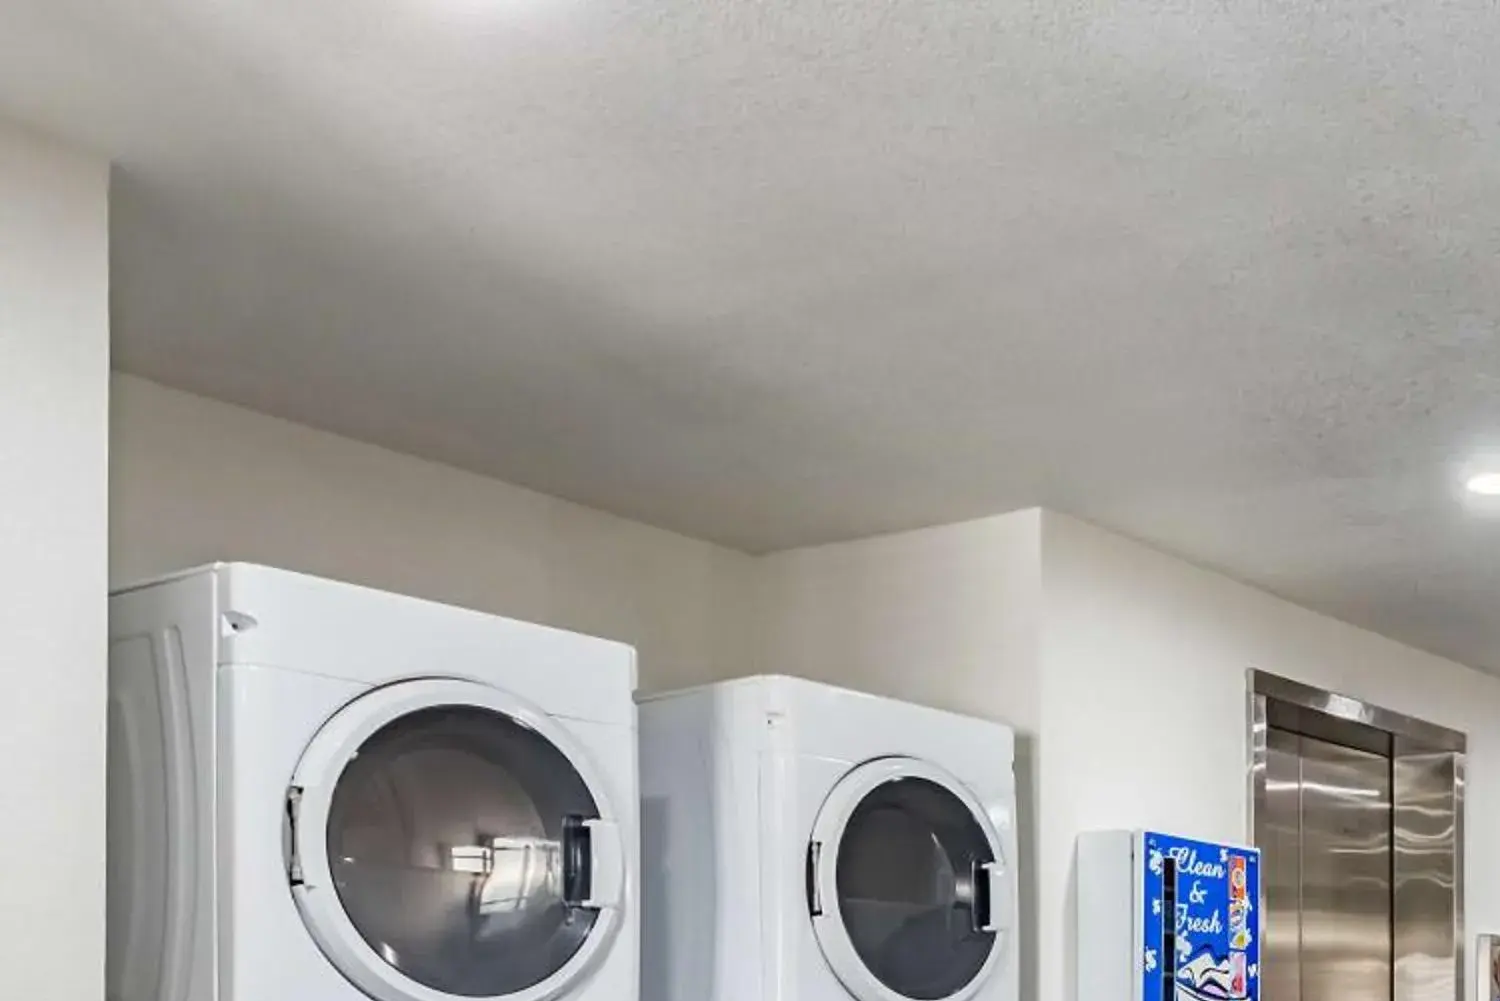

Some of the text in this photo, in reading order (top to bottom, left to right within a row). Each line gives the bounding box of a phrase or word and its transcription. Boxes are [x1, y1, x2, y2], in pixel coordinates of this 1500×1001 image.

[1169, 847, 1225, 878] Clean
[1189, 881, 1208, 904] &
[1174, 903, 1224, 934] Fresh
